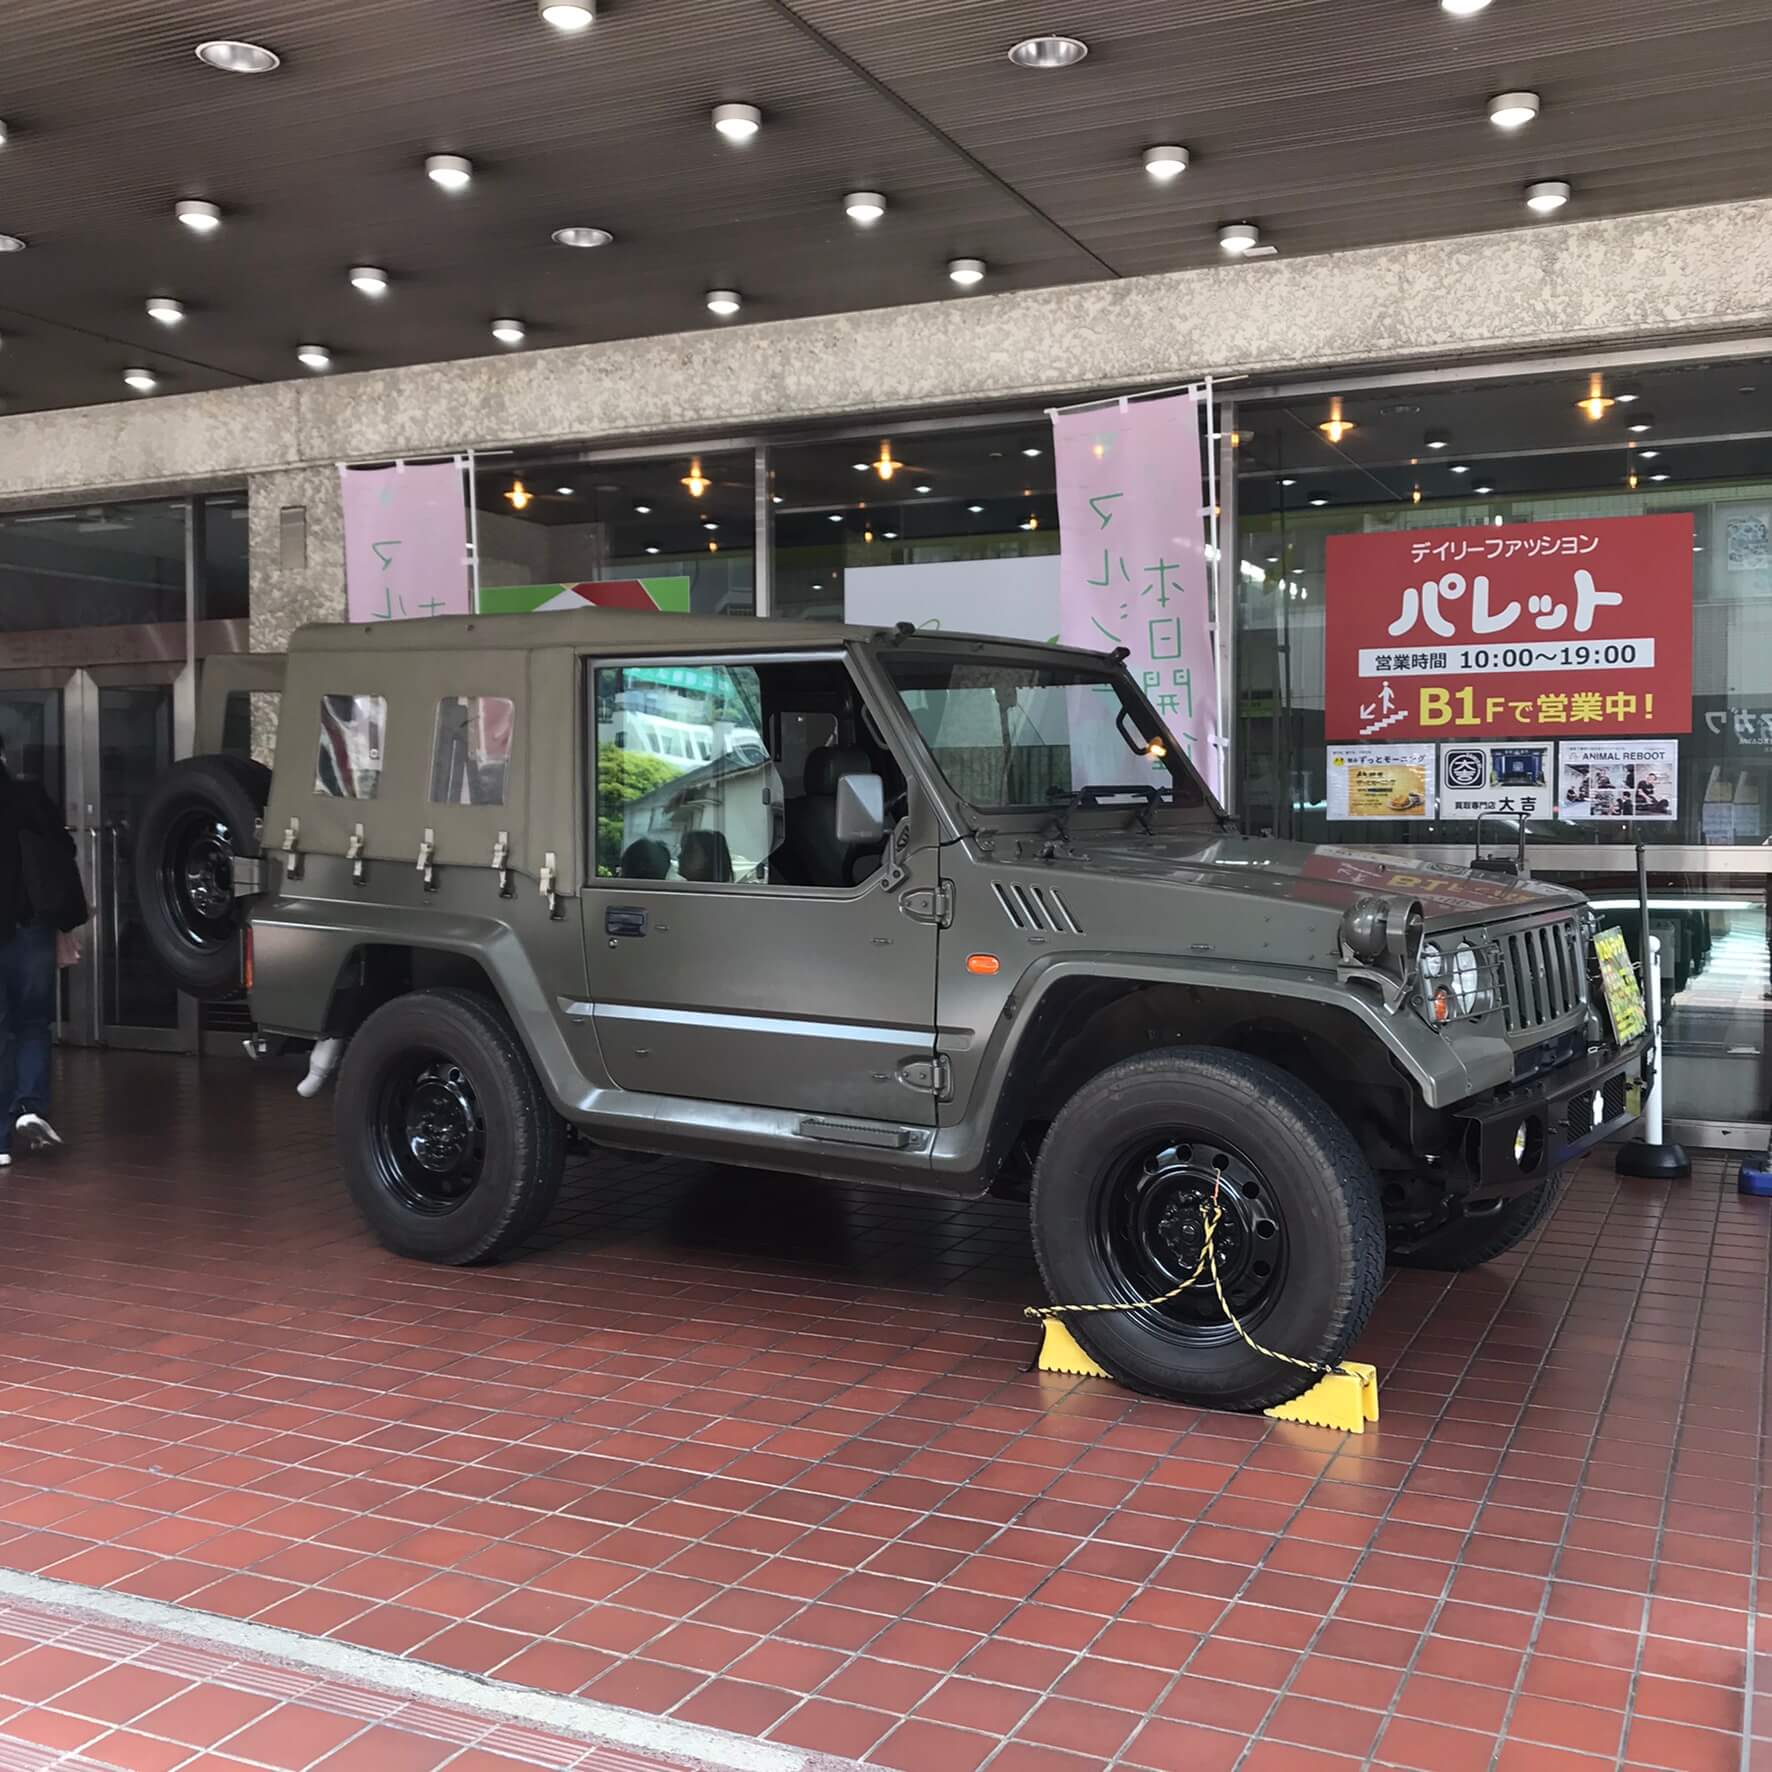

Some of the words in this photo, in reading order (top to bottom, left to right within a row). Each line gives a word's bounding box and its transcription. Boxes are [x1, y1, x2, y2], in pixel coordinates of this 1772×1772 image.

[1410, 534, 1600, 564] デイリーファッション
[1387, 568, 1624, 638] パレット
[1375, 652, 1448, 671] 営業時間
[1459, 644, 1636, 669] 10:00～19:00
[1582, 752, 1620, 760] ANIMAL
[1623, 751, 1666, 760] REBOOT
